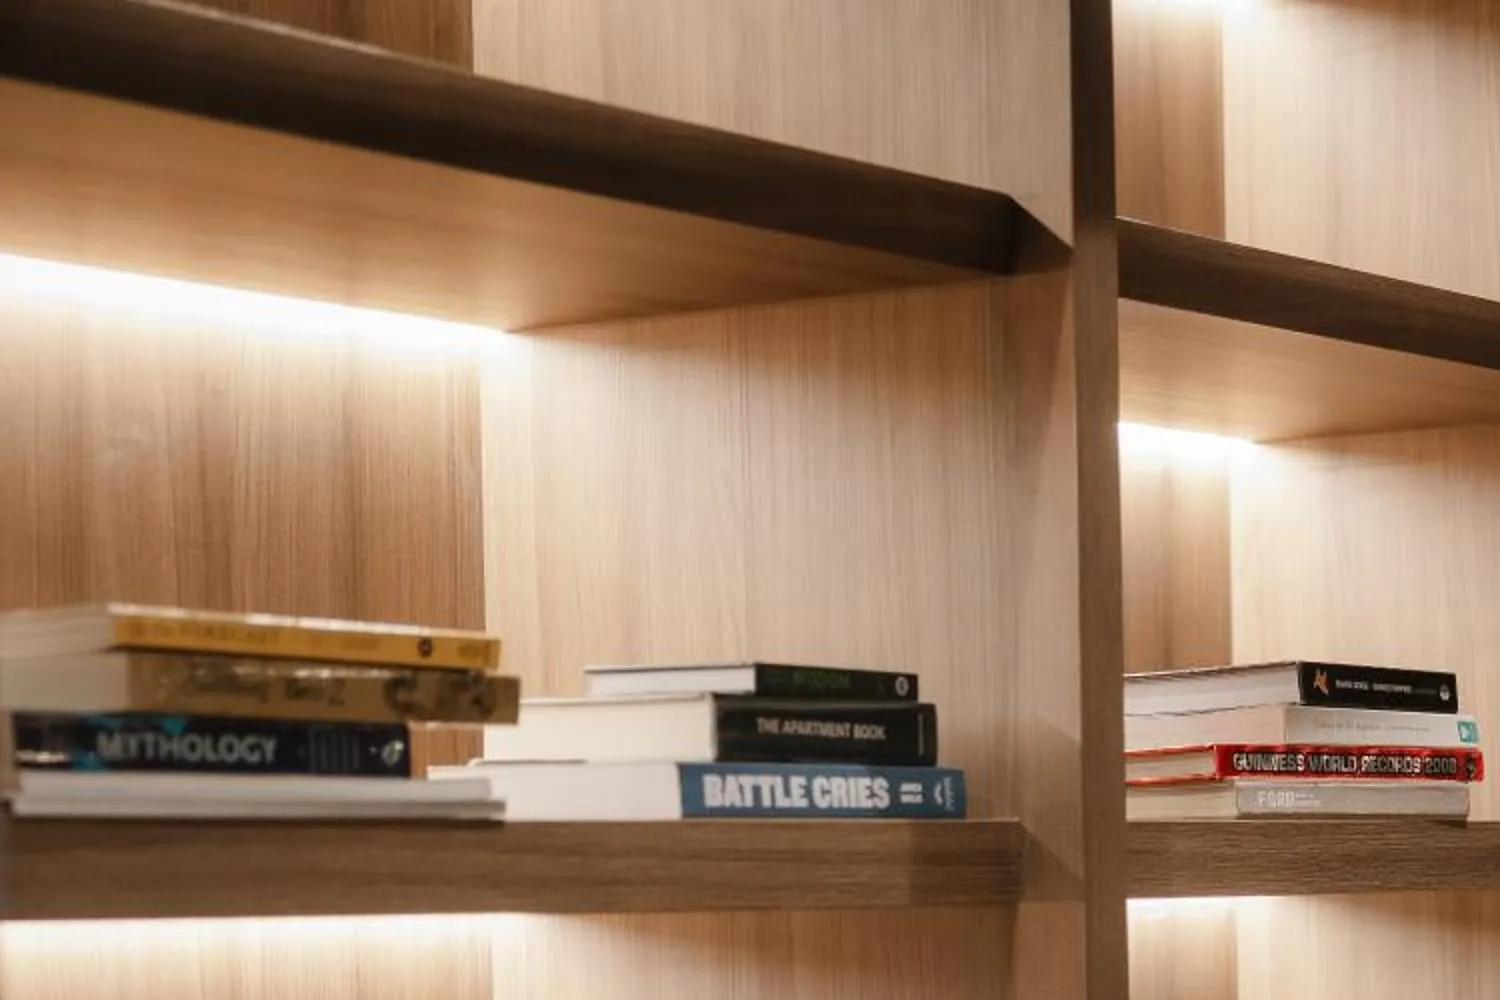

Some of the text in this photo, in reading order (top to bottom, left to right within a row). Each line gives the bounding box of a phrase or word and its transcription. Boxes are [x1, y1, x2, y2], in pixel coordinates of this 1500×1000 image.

[756, 717, 886, 740] THE APARTMENT BOOK
[97, 732, 277, 764] MYTHOLOGY
[1233, 753, 1305, 772] GUINNESS
[1309, 755, 1357, 772] WORLD
[1361, 756, 1421, 773] RECORDS
[702, 774, 809, 809] BATTLE
[811, 777, 890, 809] CRIES
